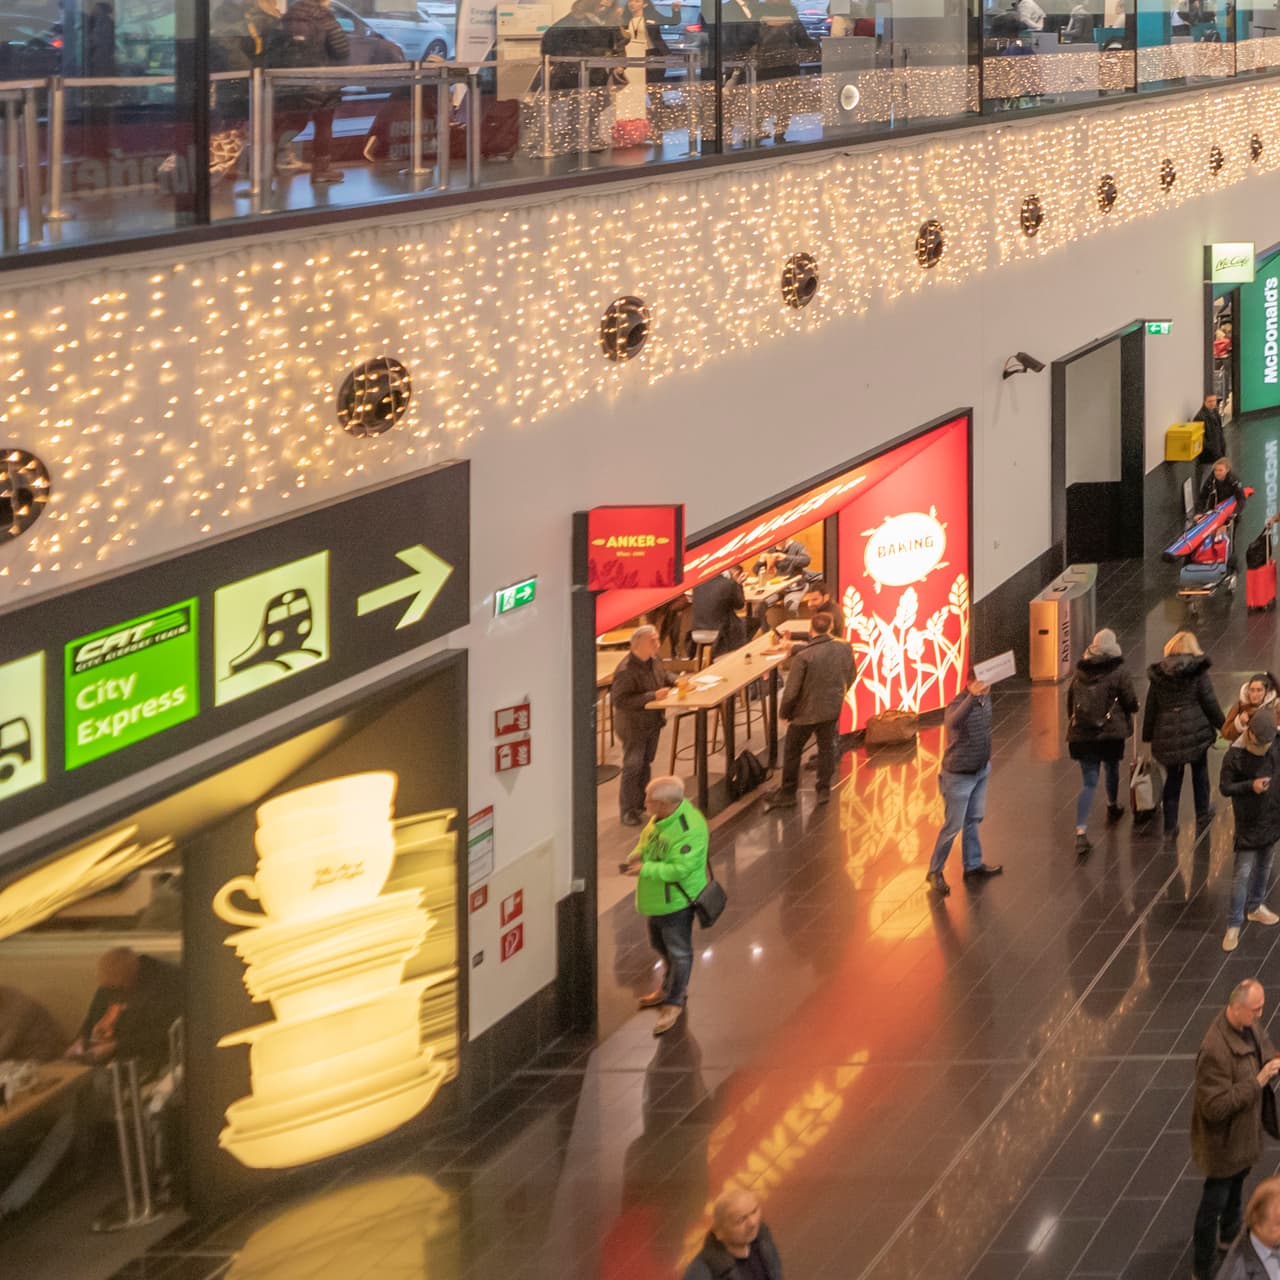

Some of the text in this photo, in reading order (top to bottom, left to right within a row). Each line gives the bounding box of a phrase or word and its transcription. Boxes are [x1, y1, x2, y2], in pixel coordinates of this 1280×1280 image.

[1264, 276, 1279, 384] McDonald's
[605, 534, 656, 549] ANKER
[876, 534, 935, 558] BAKING
[76, 671, 138, 711] City
[77, 684, 188, 747] Express
